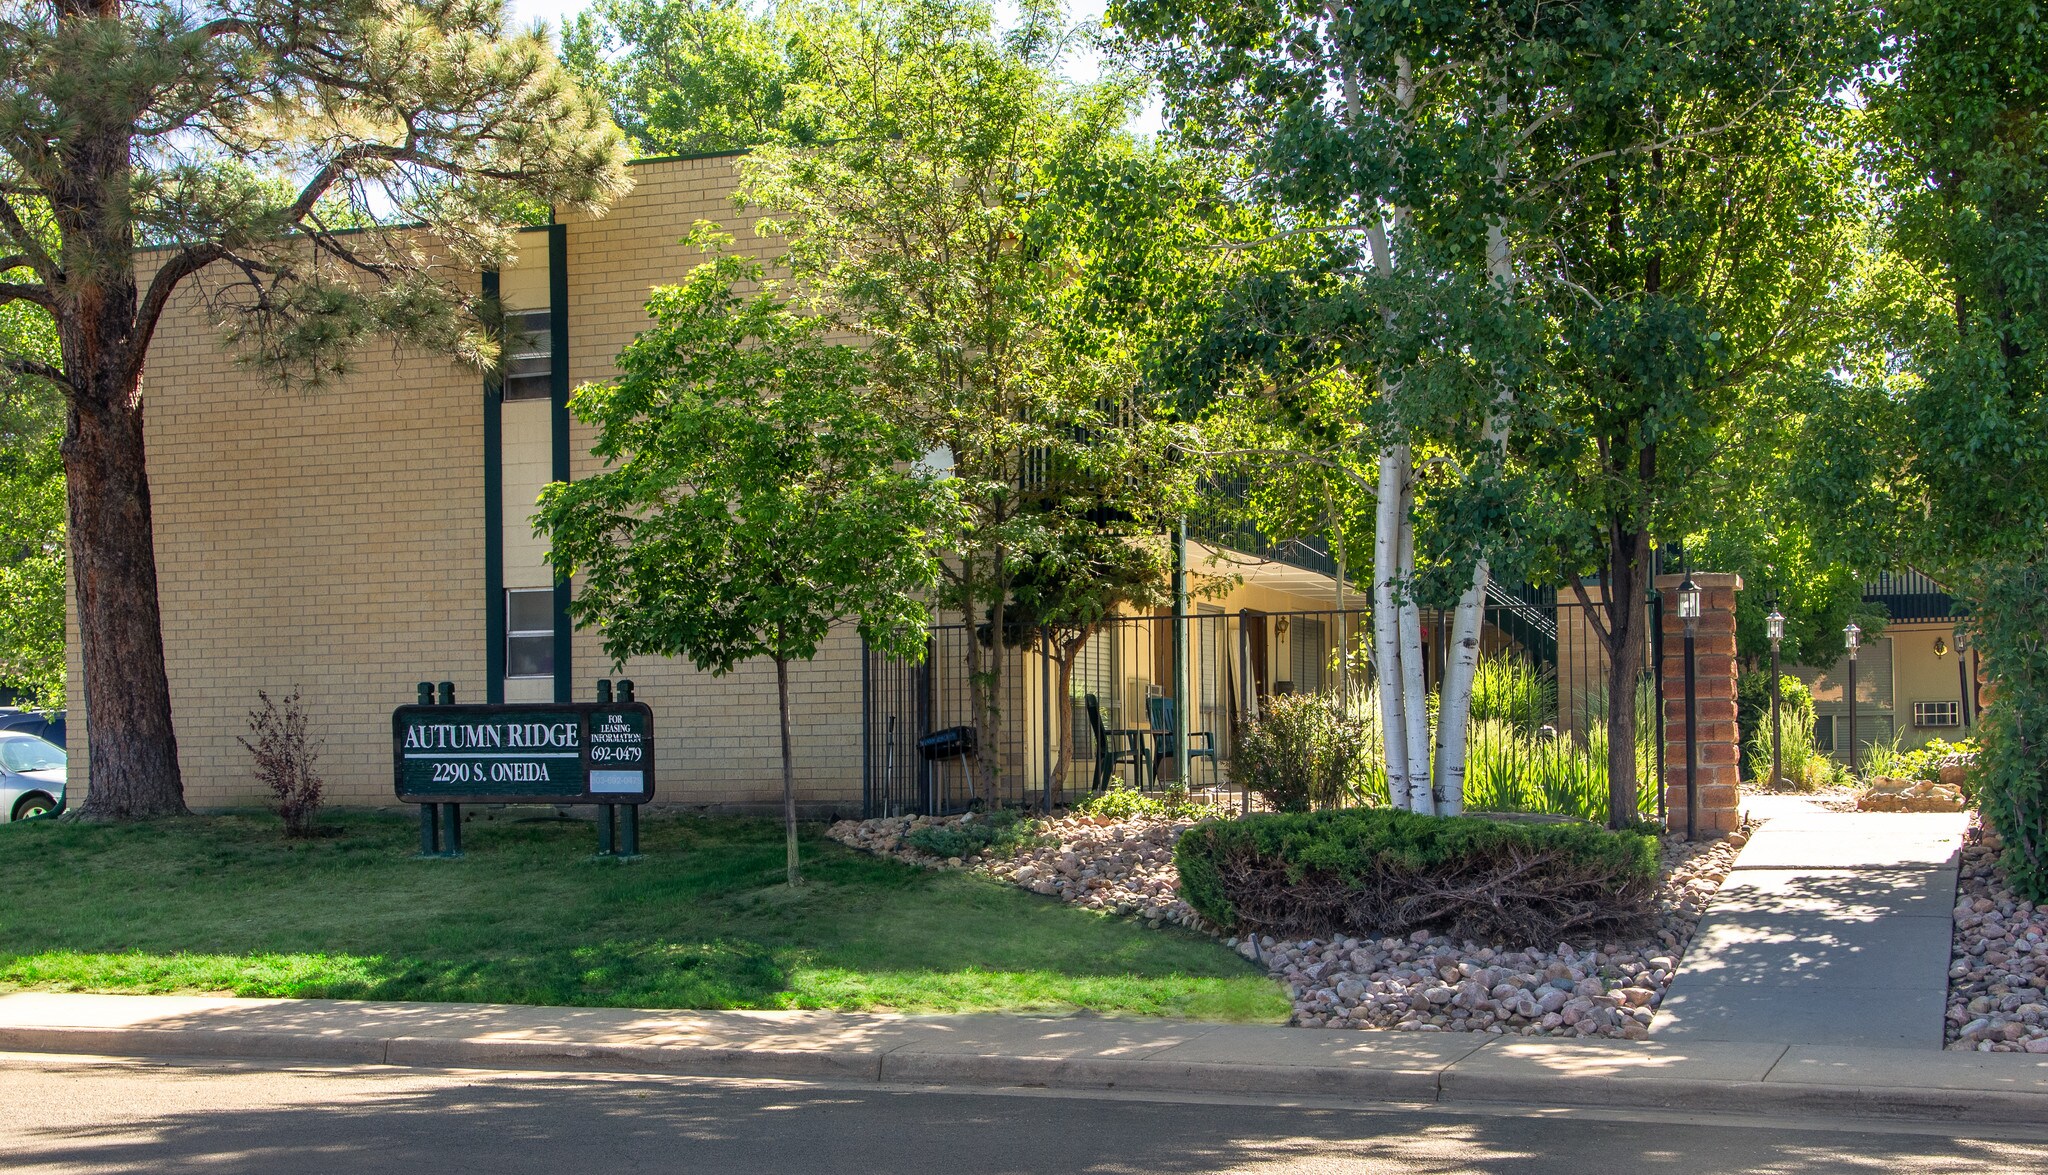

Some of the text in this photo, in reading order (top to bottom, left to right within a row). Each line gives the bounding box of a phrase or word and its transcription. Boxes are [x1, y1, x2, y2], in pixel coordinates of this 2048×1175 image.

[608, 714, 623, 724] FOR
[601, 724, 631, 733] LEASING
[404, 723, 579, 748] AUTUMN RIDGE
[591, 733, 641, 743] INFORMATION
[591, 745, 642, 762] 692-0479
[432, 762, 550, 784] 2290 S. ONEIDA
